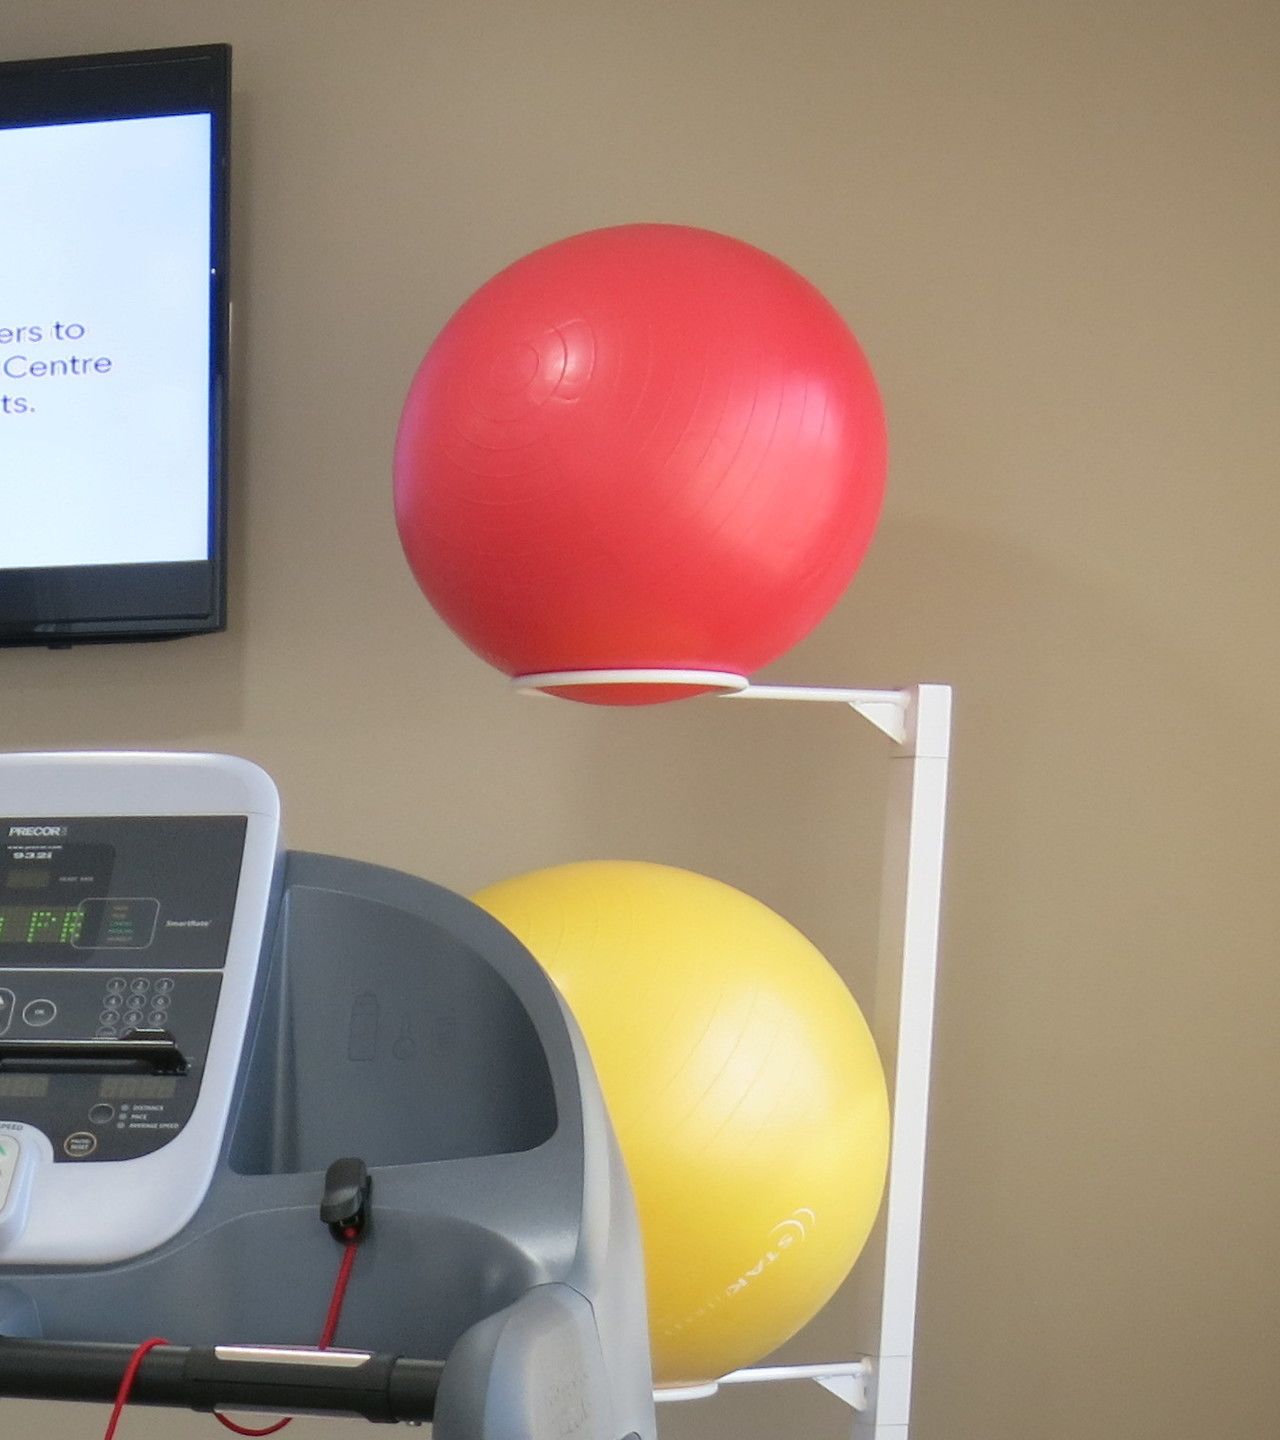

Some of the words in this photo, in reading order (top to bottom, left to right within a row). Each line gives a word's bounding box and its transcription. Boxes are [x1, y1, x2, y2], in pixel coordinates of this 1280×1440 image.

[53, 321, 86, 341] to
[3, 355, 113, 379] Centre
[7, 826, 61, 837] PRECOR
